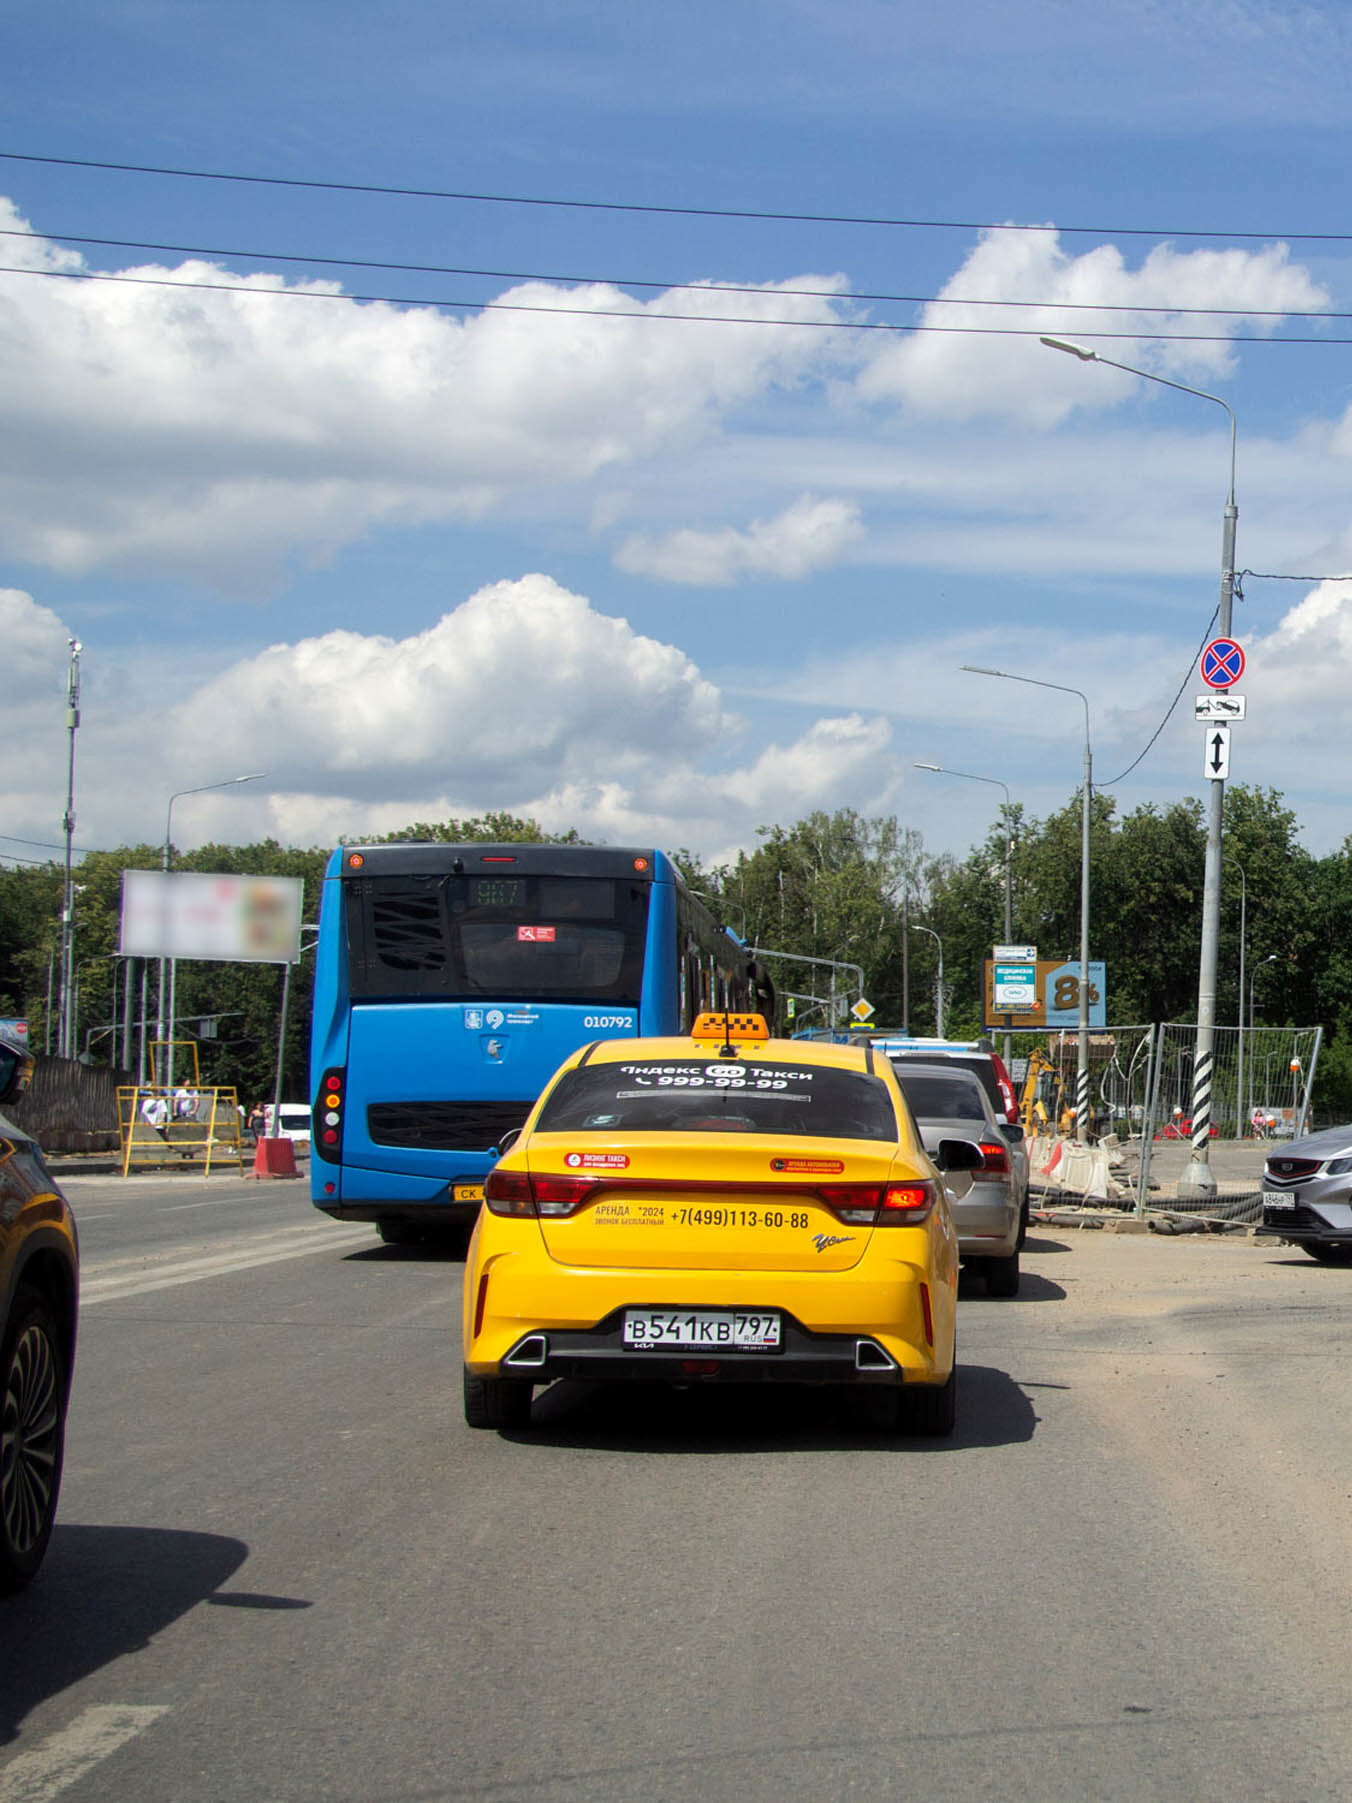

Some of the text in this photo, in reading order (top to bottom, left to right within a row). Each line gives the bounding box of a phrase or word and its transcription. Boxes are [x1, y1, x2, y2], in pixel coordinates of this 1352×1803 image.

[583, 1016, 633, 1029] 010792
[620, 1065, 701, 1076] Яндекс
[750, 1067, 814, 1081] Такси
[657, 1076, 788, 1090] 999-99-99
[595, 1203, 631, 1216] АРЕНДА
[671, 1208, 809, 1229] +7(499)113-60-88
[743, 1335, 762, 1343] RUS
